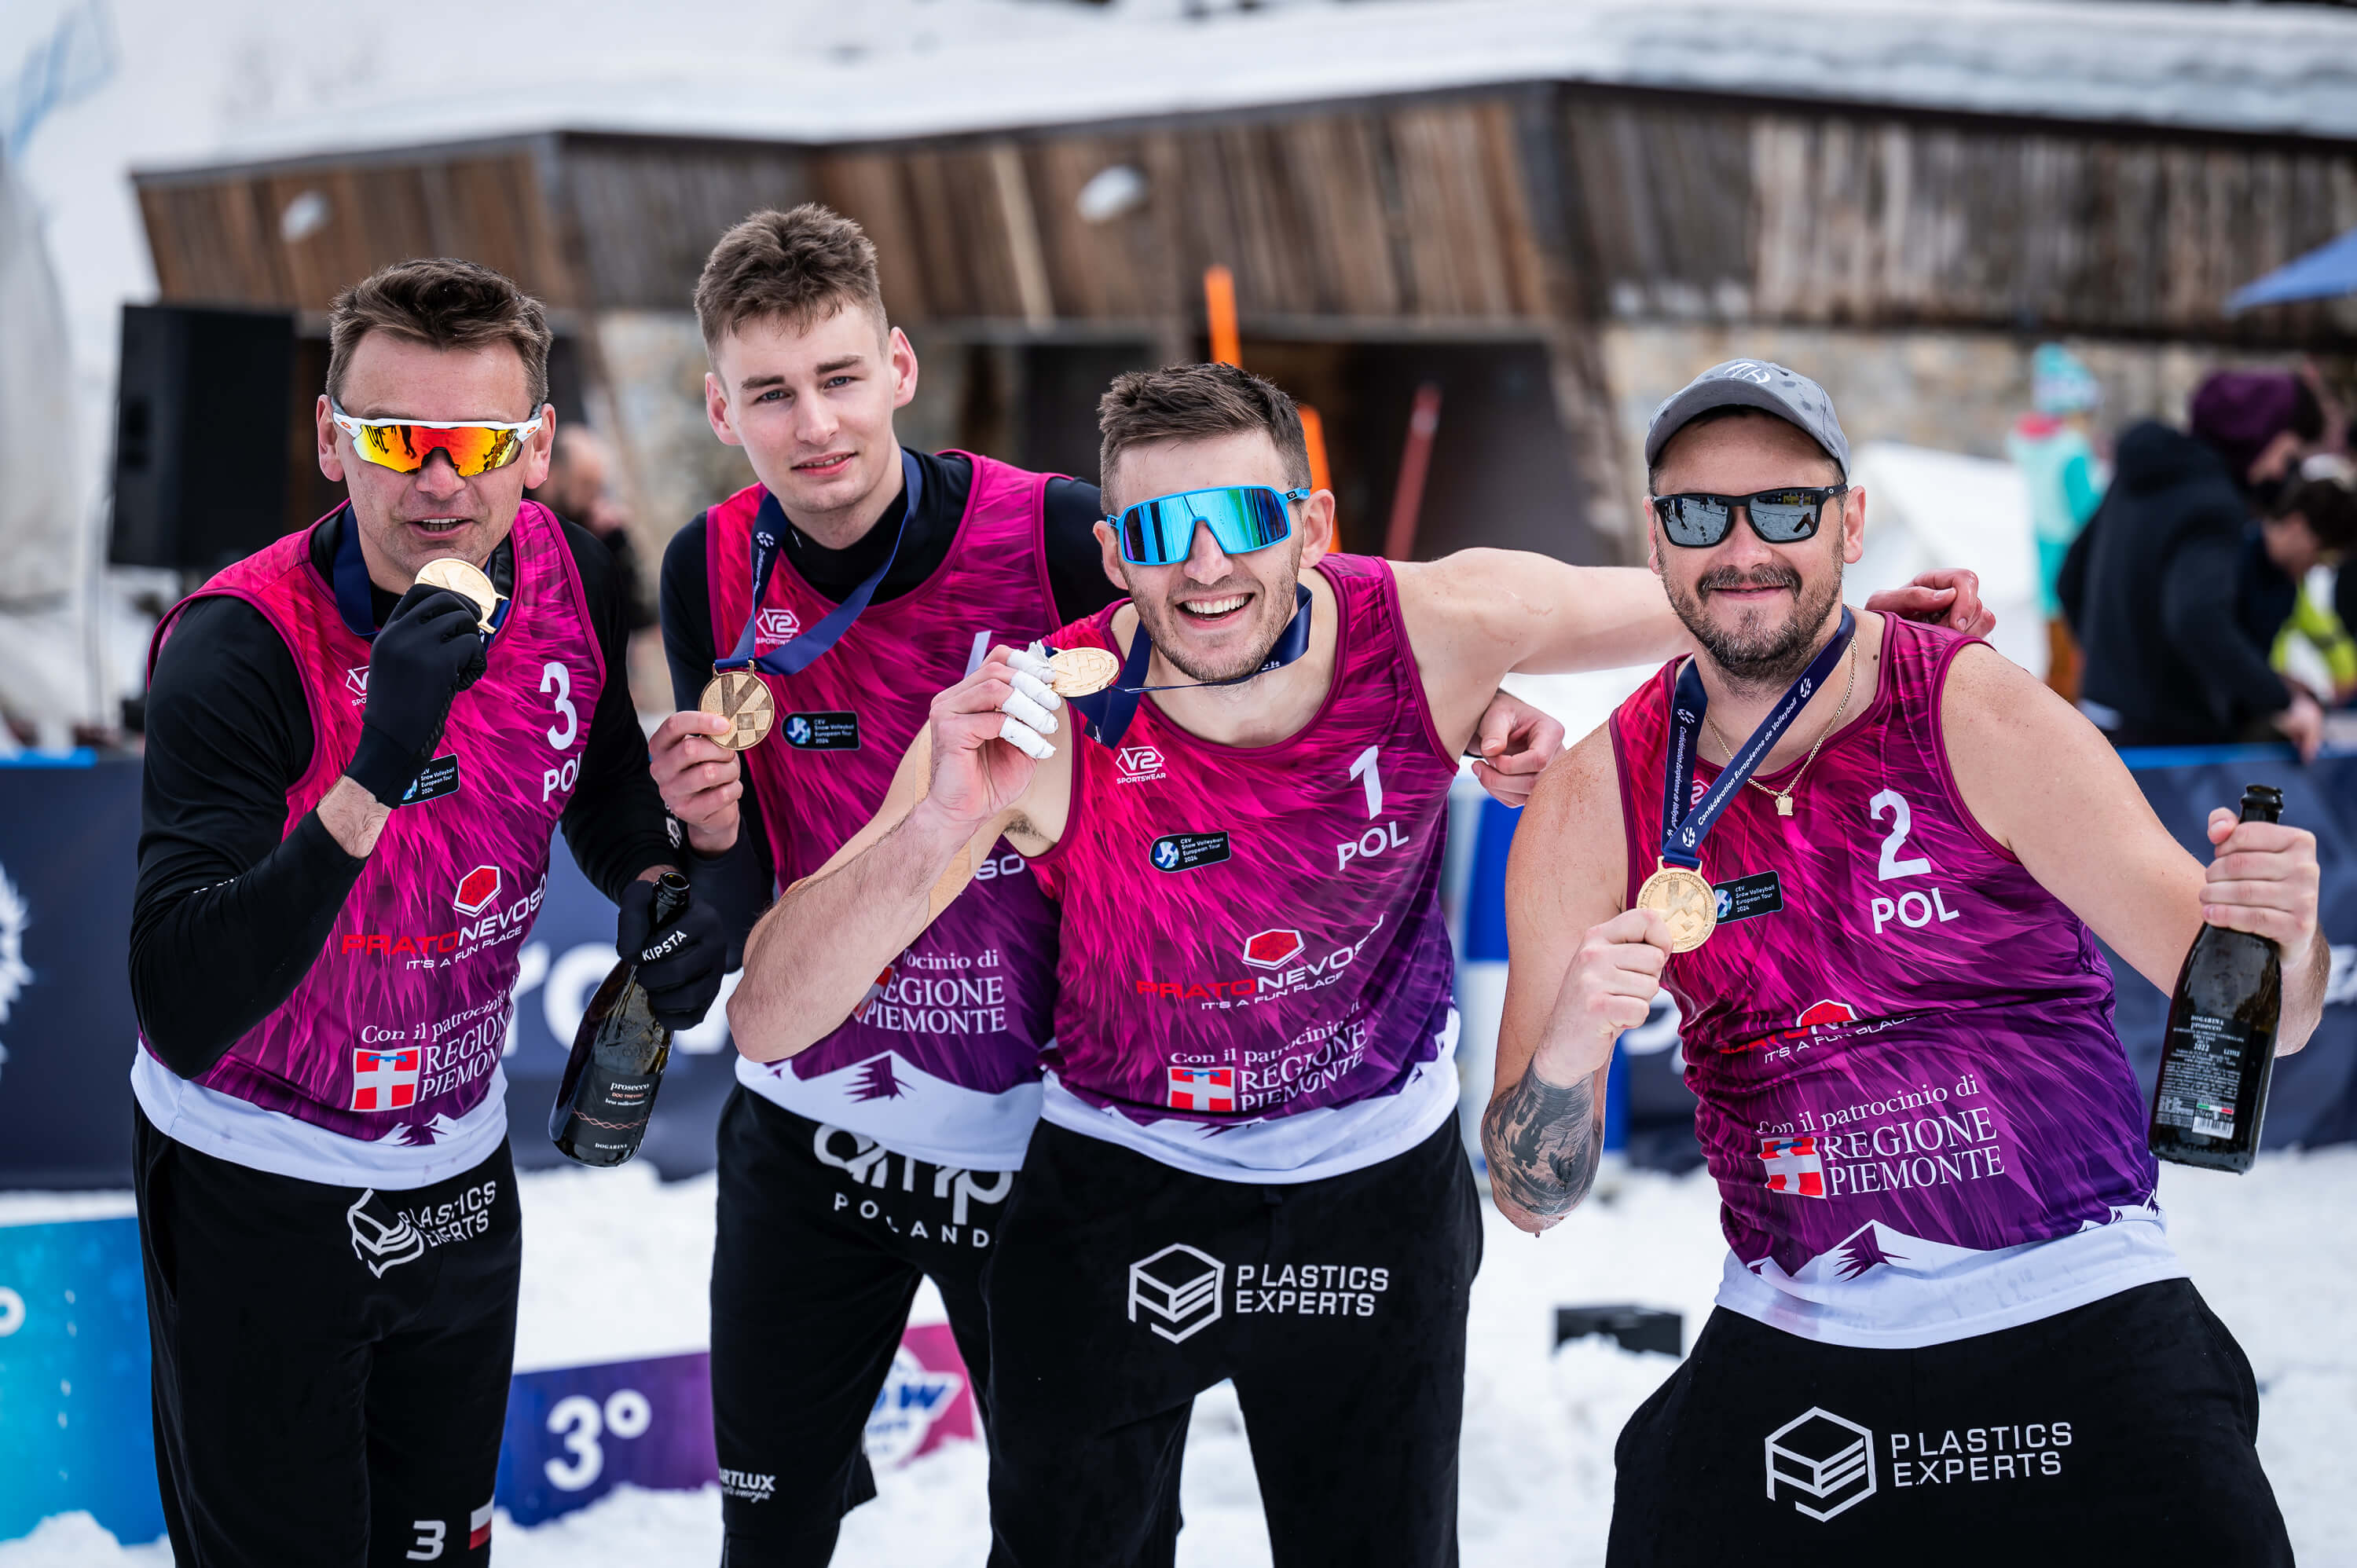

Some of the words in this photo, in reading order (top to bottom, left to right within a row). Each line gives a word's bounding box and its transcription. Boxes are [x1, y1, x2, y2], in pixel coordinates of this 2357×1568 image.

[540, 662, 577, 750] 3
[1116, 773, 1166, 784] SPORTSWEAR
[1121, 748, 1162, 770] V2
[1698, 778, 1736, 826] Confédération
[1735, 741, 1765, 779] Européenne
[1765, 731, 1772, 741] de
[1772, 698, 1797, 731] Volleyball
[1348, 745, 1383, 820] 1
[1182, 846, 1208, 856] European
[1197, 837, 1223, 846] Volleyball
[1336, 820, 1409, 870] POL
[1869, 789, 1931, 881] 2
[1736, 896, 1760, 906] European
[1749, 884, 1775, 894] Volleyball
[1871, 887, 1959, 934] POL
[406, 959, 434, 970] IT'S
[440, 958, 451, 968] A
[455, 943, 478, 963] FUN
[482, 925, 522, 949] PLACE
[641, 929, 687, 962] KIPSTA
[977, 949, 999, 968] di
[880, 973, 1006, 1006] EGIONE
[1201, 1001, 1231, 1011] IT'S
[1255, 989, 1288, 1005] FUN
[361, 1025, 405, 1043] Con
[412, 1022, 427, 1040] il
[432, 989, 506, 1042] patrocinio
[863, 998, 1007, 1035] PIEMONTE
[1171, 1051, 1215, 1064] Con
[1223, 1048, 1237, 1061] il
[1244, 1020, 1344, 1067] patrocinio
[1238, 1019, 1368, 1093] REGIONE
[1765, 1046, 1790, 1064] IT'S
[1796, 1041, 1810, 1052] A
[610, 1082, 650, 1091] prosecco
[1240, 1046, 1365, 1112] PIEMONTE
[1798, 1112, 1816, 1133] il
[1820, 1083, 1948, 1132] patrocinio
[1955, 1074, 1981, 1097] di
[1824, 1106, 1998, 1162] REGIONE
[1827, 1145, 2005, 1196] PIEMONTE
[834, 1192, 989, 1247] POLAND
[1237, 1264, 1390, 1293] PLASTICS
[1235, 1288, 1376, 1317] EXPERTS
[1890, 1420, 2073, 1460] PLASTICS
[1893, 1451, 2062, 1488] EXPERTS
[405, 1519, 446, 1560] 3
